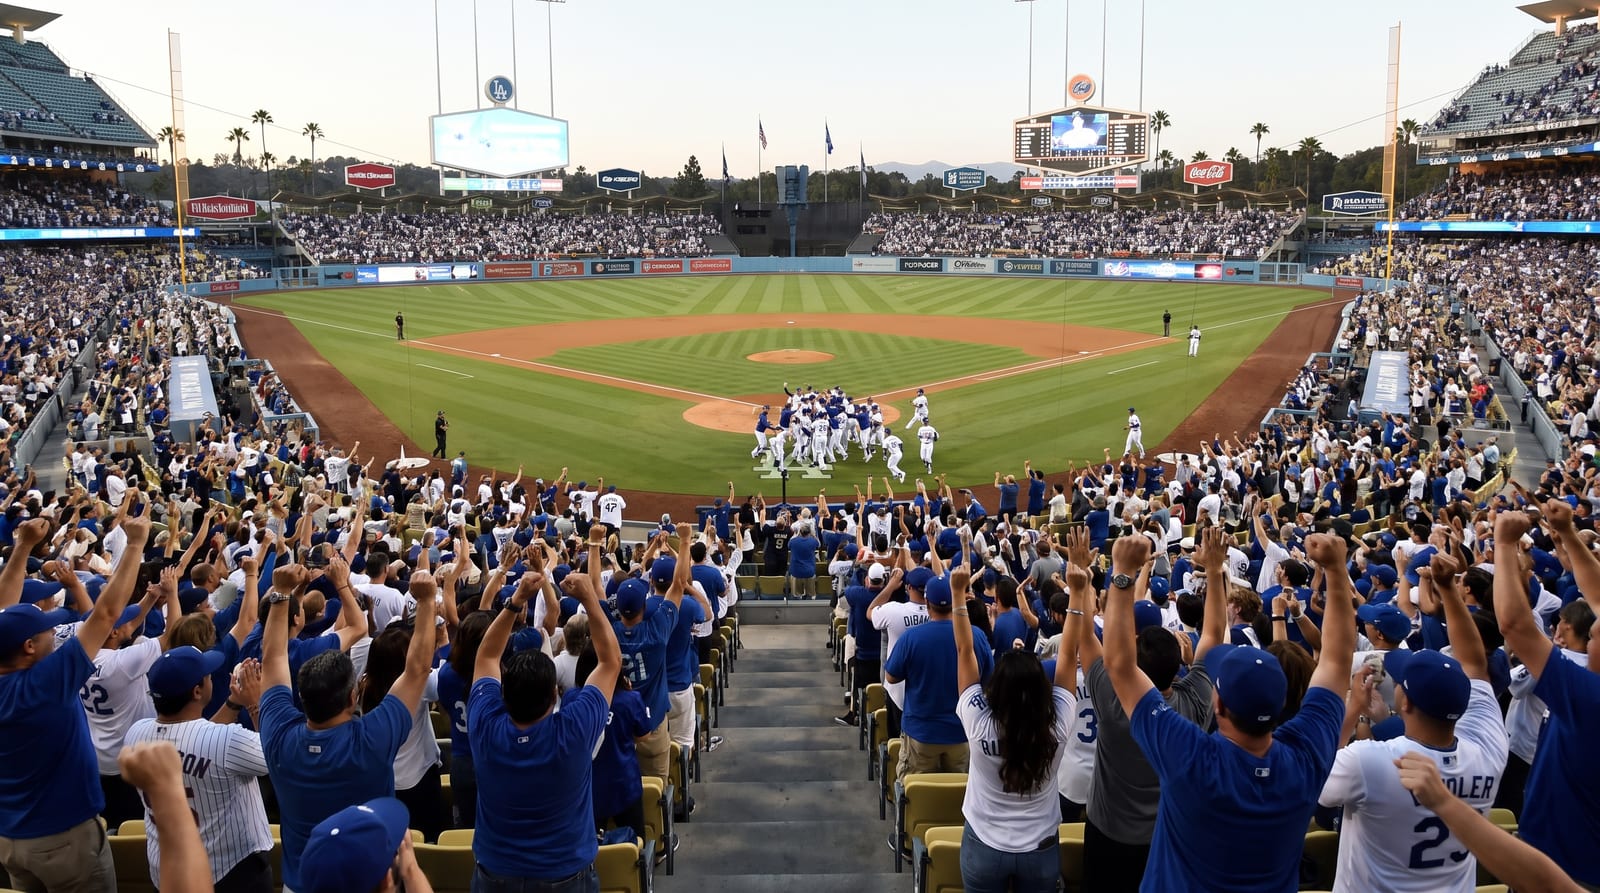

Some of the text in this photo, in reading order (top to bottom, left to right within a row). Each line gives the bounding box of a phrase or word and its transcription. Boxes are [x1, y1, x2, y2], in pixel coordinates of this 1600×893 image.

[494, 80, 507, 99] LA
[605, 503, 617, 512] 47
[775, 538, 785, 550] 9
[80, 683, 114, 715] 22
[1077, 708, 1098, 743] 3
